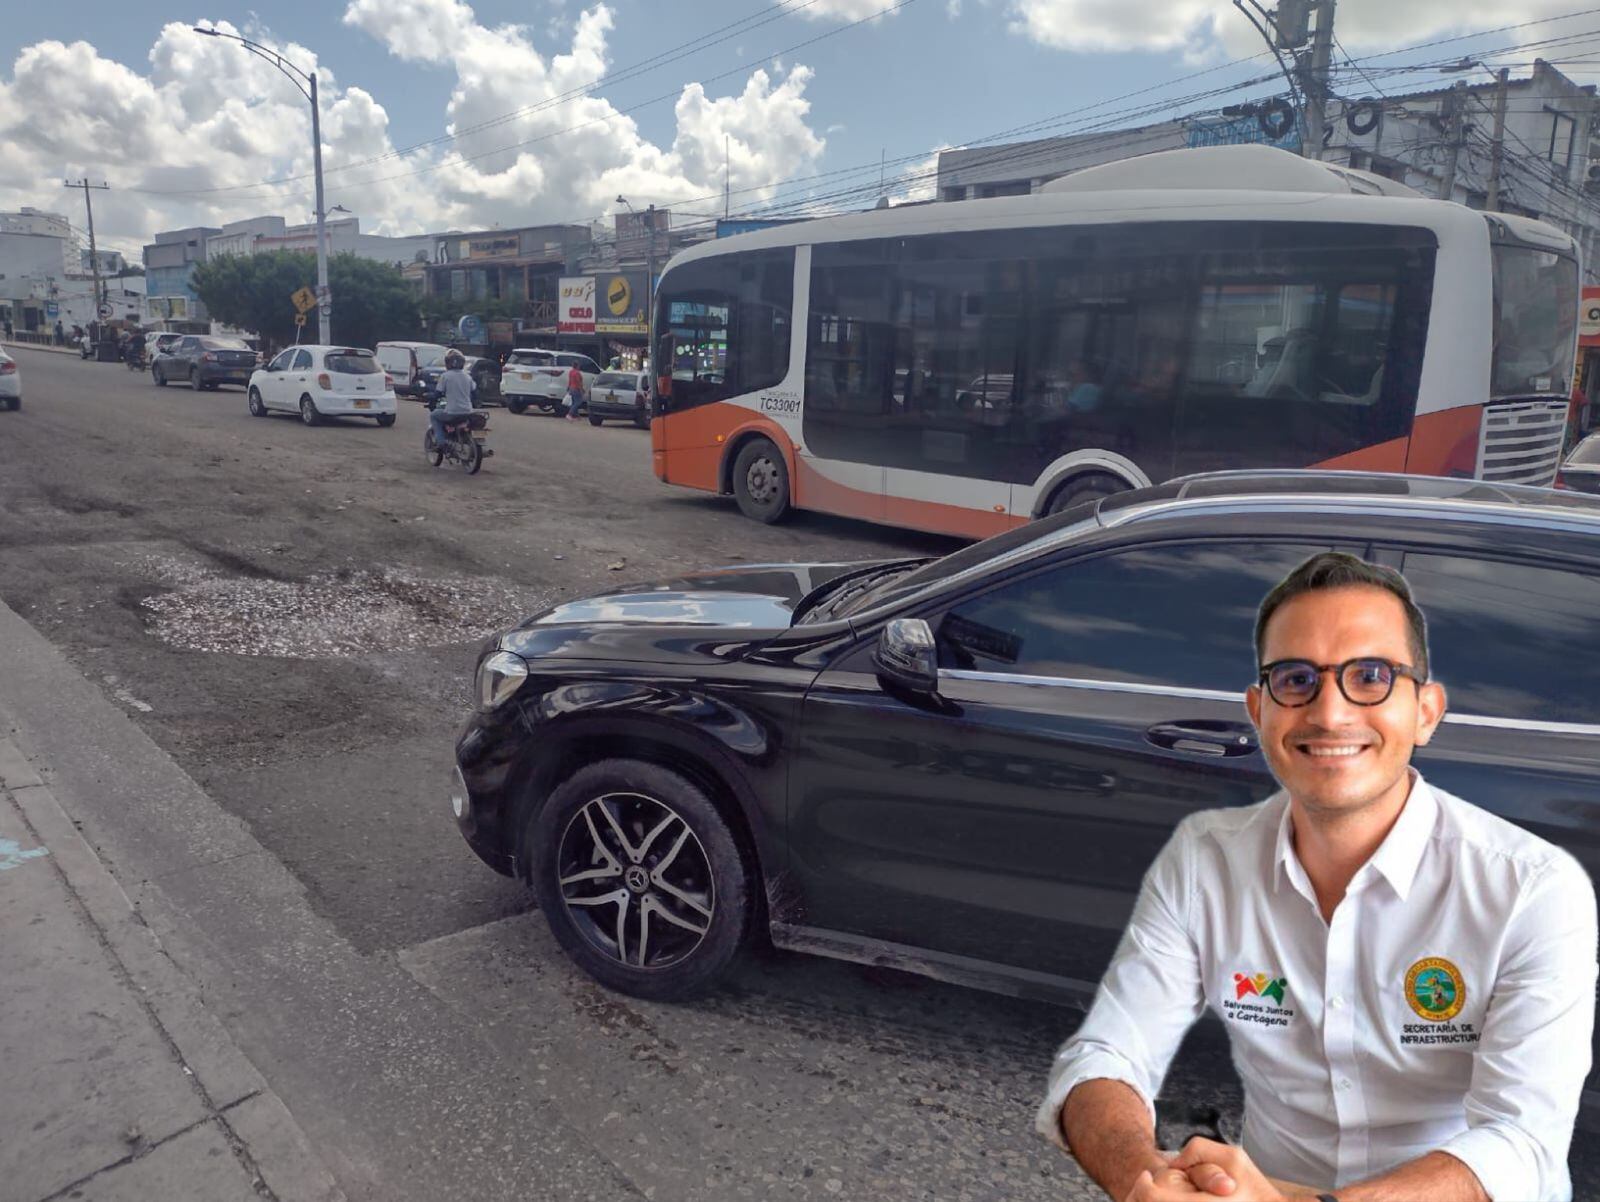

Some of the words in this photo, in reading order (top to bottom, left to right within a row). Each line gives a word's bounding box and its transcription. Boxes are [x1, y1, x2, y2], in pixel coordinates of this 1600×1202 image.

[760, 398, 801, 412] TC33001
[1223, 1000, 1264, 1012] Salvemos
[1265, 1006, 1294, 1016] Juntos
[1236, 1010, 1288, 1026] Cartagena
[1403, 1021, 1458, 1033] SECRETARÍA
[1461, 1023, 1474, 1032] DE
